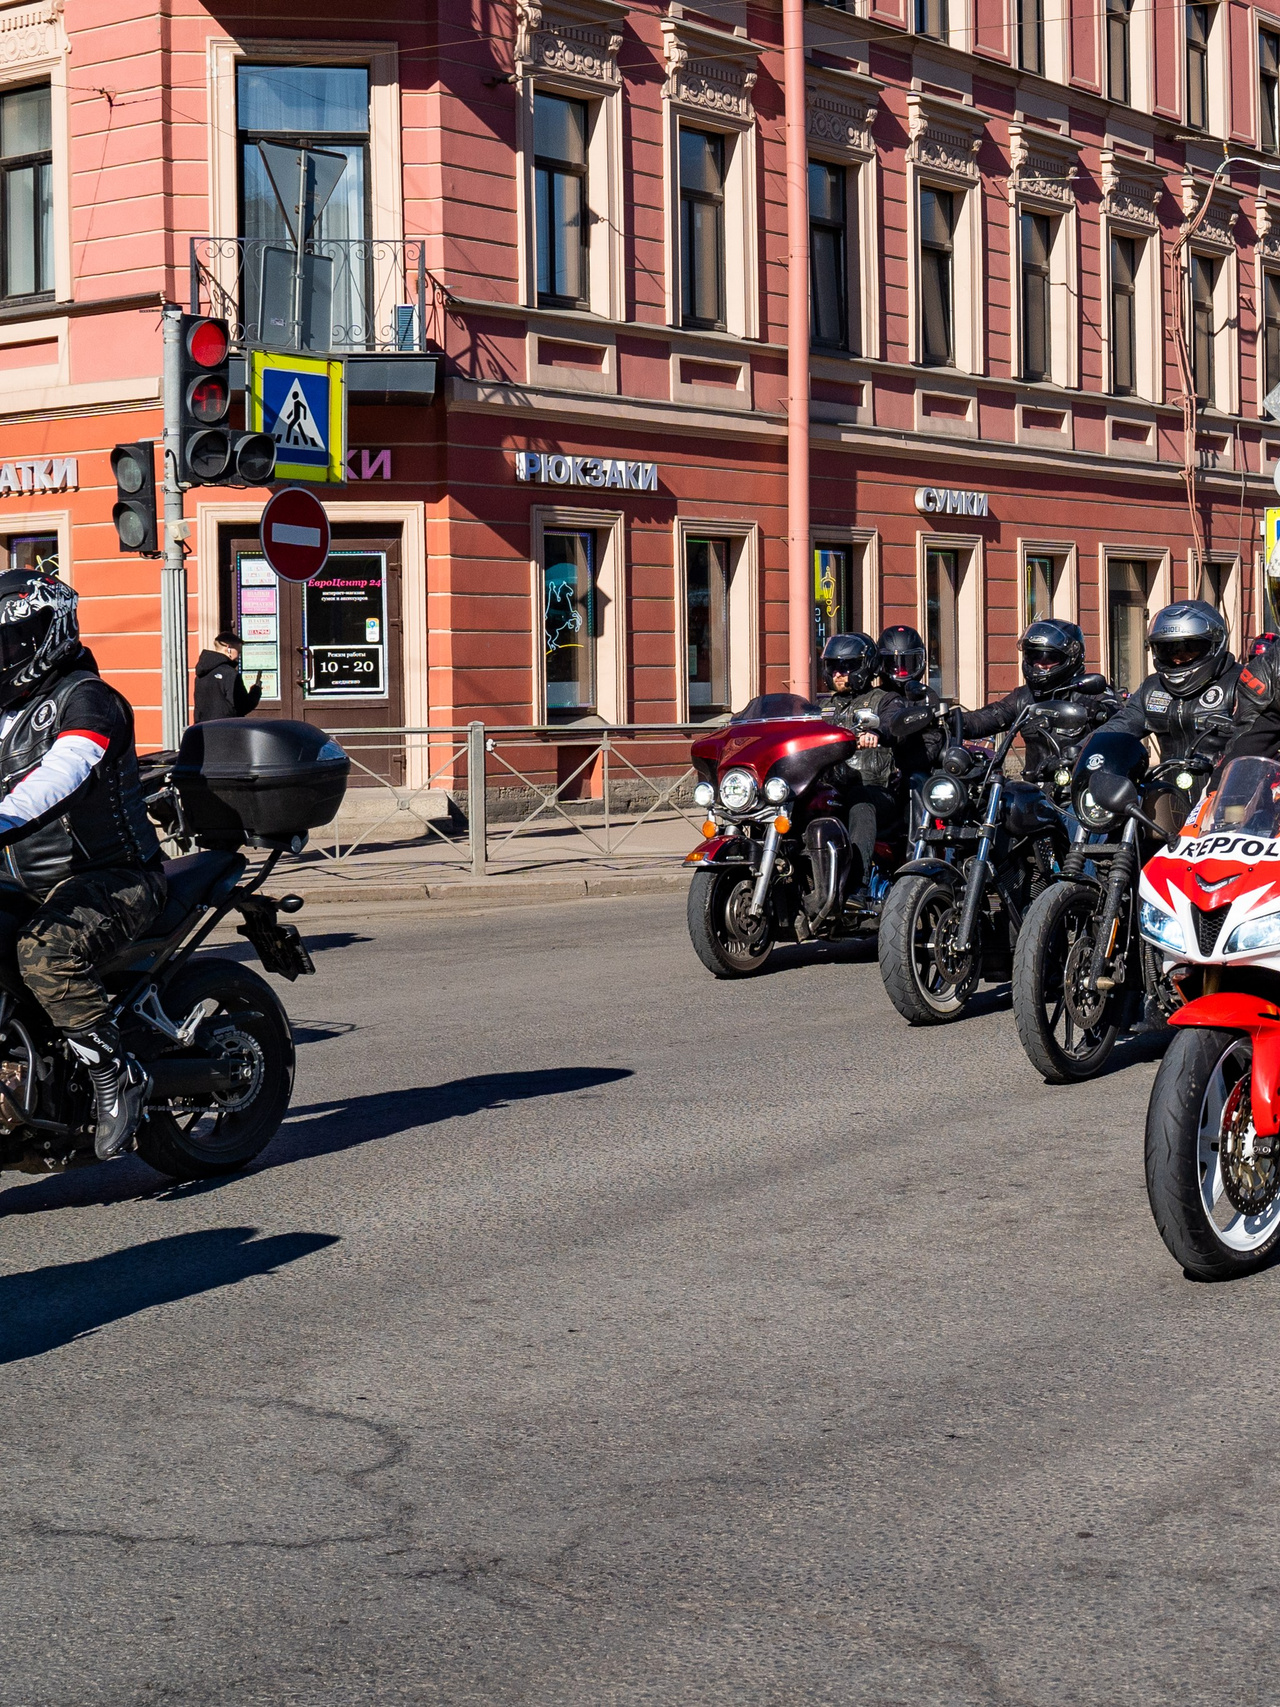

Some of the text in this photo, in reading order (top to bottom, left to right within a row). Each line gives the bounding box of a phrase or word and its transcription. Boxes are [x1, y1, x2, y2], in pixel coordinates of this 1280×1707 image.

[0, 457, 78, 492] АТКИ
[516, 451, 658, 491] РЮКЗАКИ
[915, 487, 988, 517] СУМКИ
[307, 578, 368, 588] ЕвроЦентр
[320, 661, 339, 673] 10
[353, 661, 374, 673] 20
[1179, 837, 1280, 859] REPSOL
[88, 1032, 114, 1054] Forma
